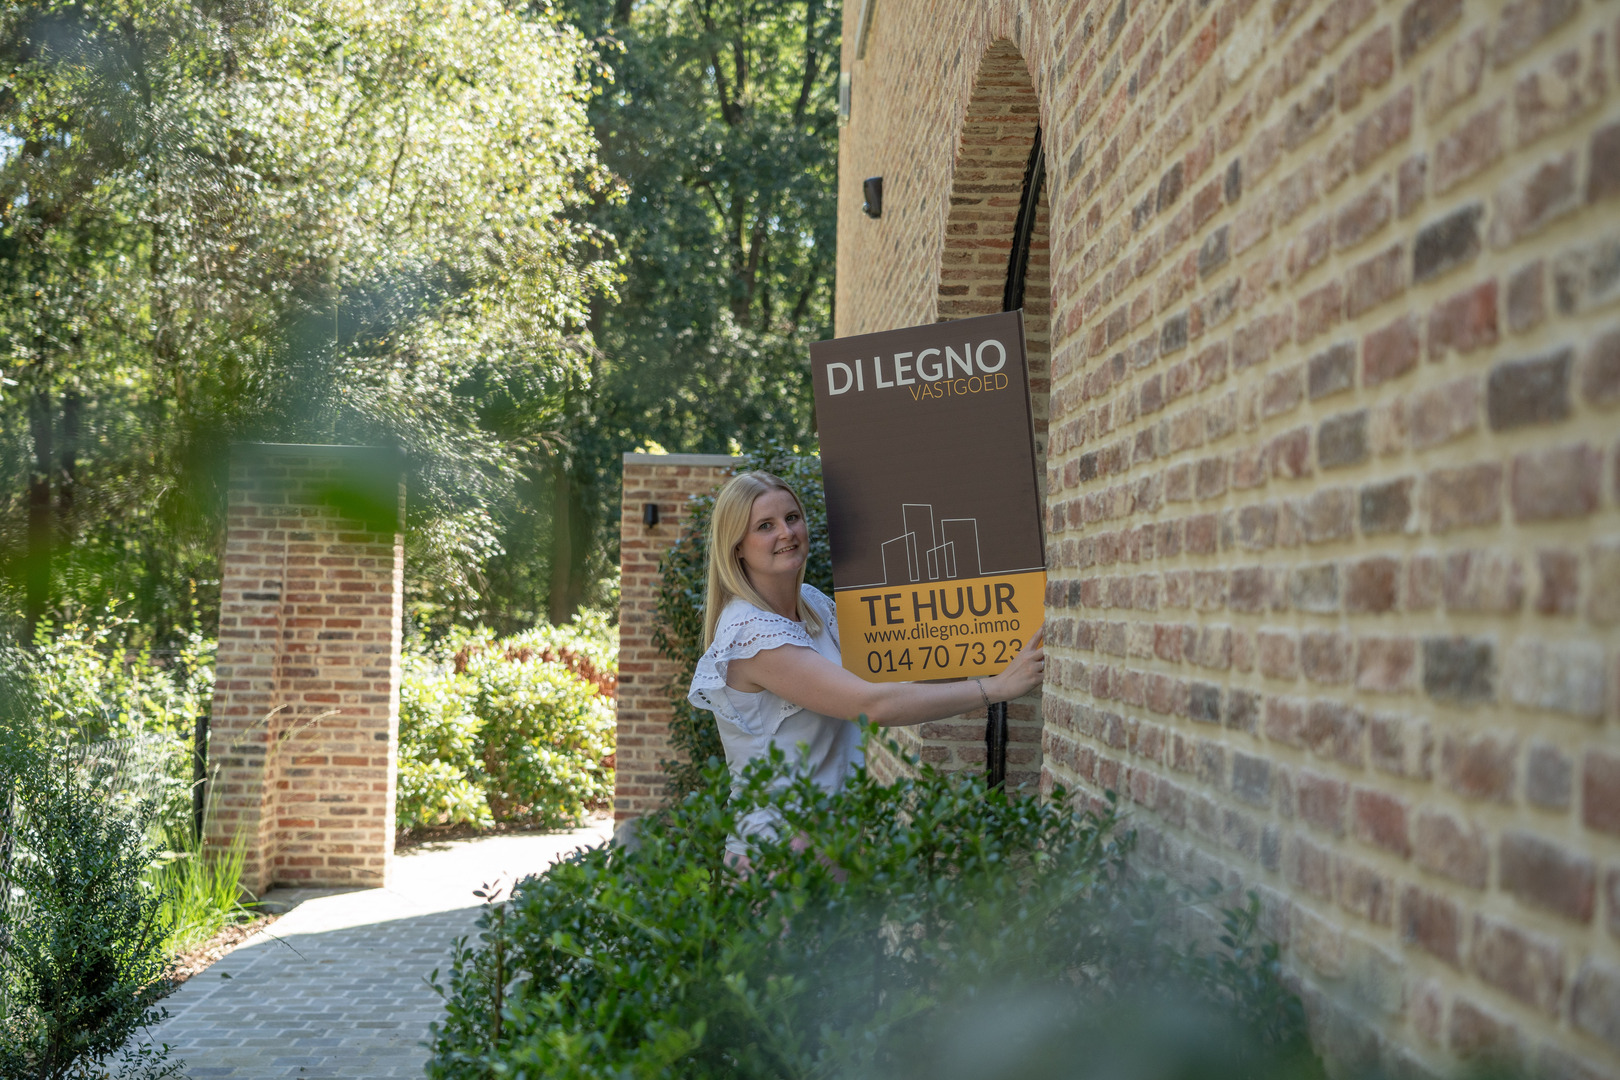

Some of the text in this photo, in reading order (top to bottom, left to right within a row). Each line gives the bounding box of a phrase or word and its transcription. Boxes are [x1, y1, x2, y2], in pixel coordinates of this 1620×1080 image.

[827, 339, 1007, 396] DI LEGNO
[909, 373, 1008, 401] VASTGOED
[860, 583, 1019, 626] TE HUUR
[864, 618, 1020, 644] www.dilegno.immo
[867, 648, 913, 673] 014
[919, 645, 950, 669] 70
[955, 642, 986, 667] 73
